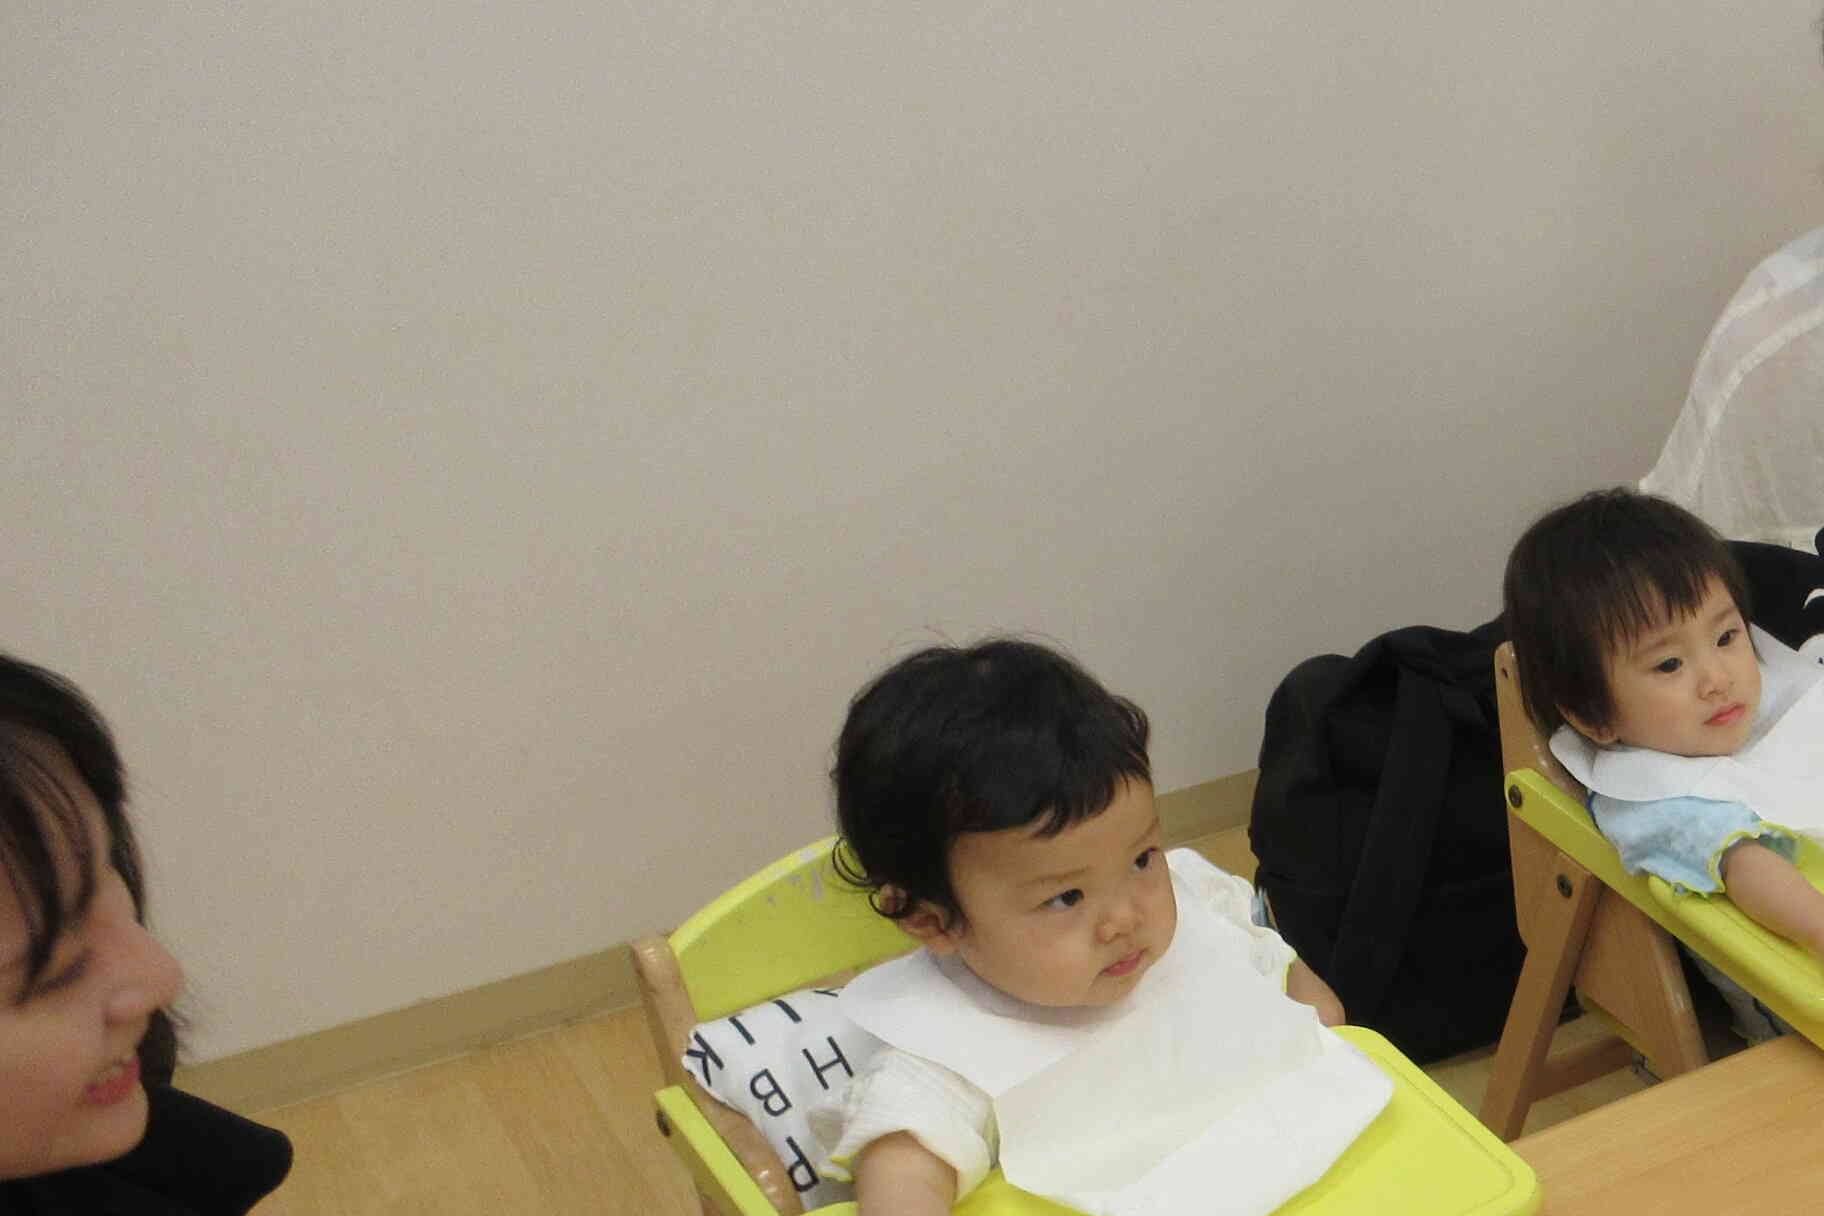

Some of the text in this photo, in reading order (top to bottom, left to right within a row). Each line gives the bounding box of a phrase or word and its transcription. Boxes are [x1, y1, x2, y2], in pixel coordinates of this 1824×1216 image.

[686, 1032, 725, 1087] K
[750, 1035, 854, 1117] H B
[786, 1136, 820, 1193] P
